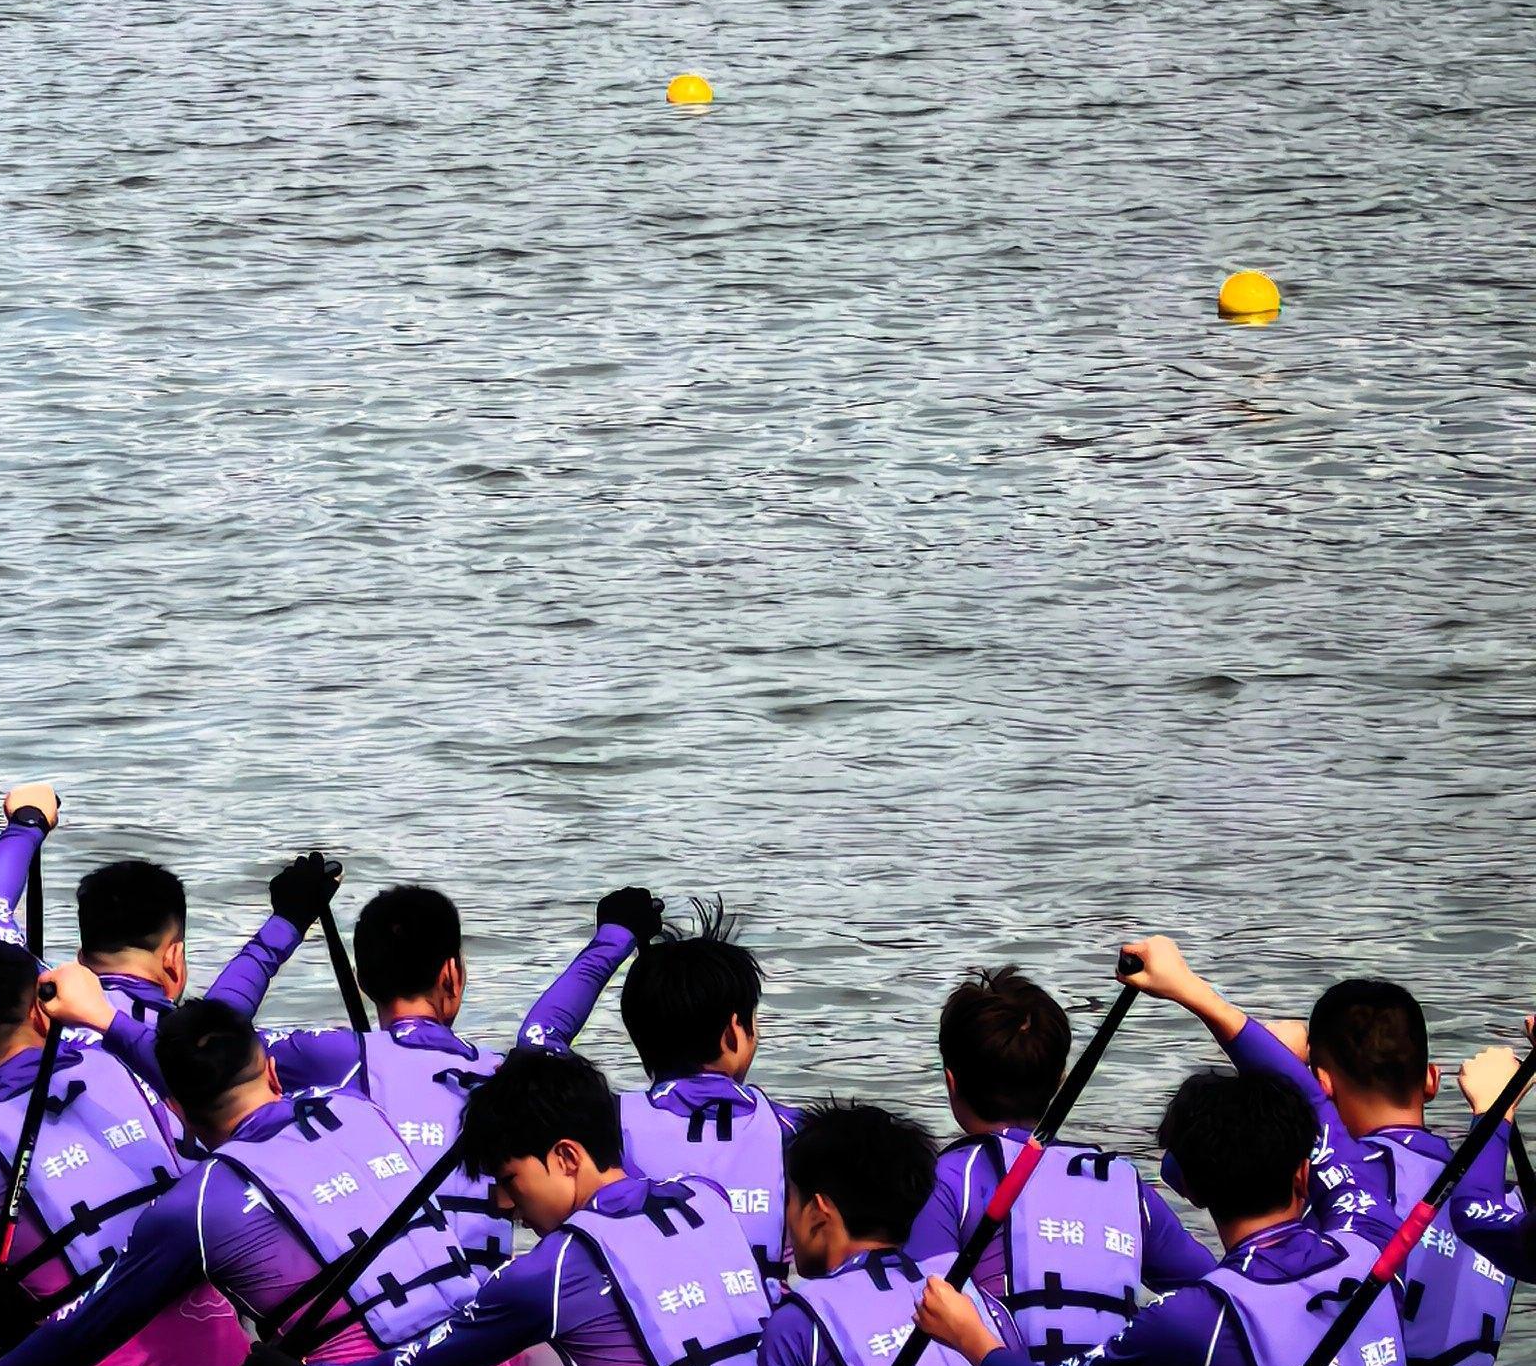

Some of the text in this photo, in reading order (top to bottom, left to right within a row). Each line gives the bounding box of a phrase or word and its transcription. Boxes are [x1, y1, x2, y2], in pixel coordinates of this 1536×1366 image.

[40, 1119, 147, 1178] 丰裕 酒店
[397, 1121, 445, 1147] 丰裕
[311, 1172, 359, 1204] 丰裕
[367, 1152, 410, 1179] 酒店
[1038, 1217, 1136, 1258] 丰裕 酒店
[657, 1269, 757, 1314] 丰裕 酒店
